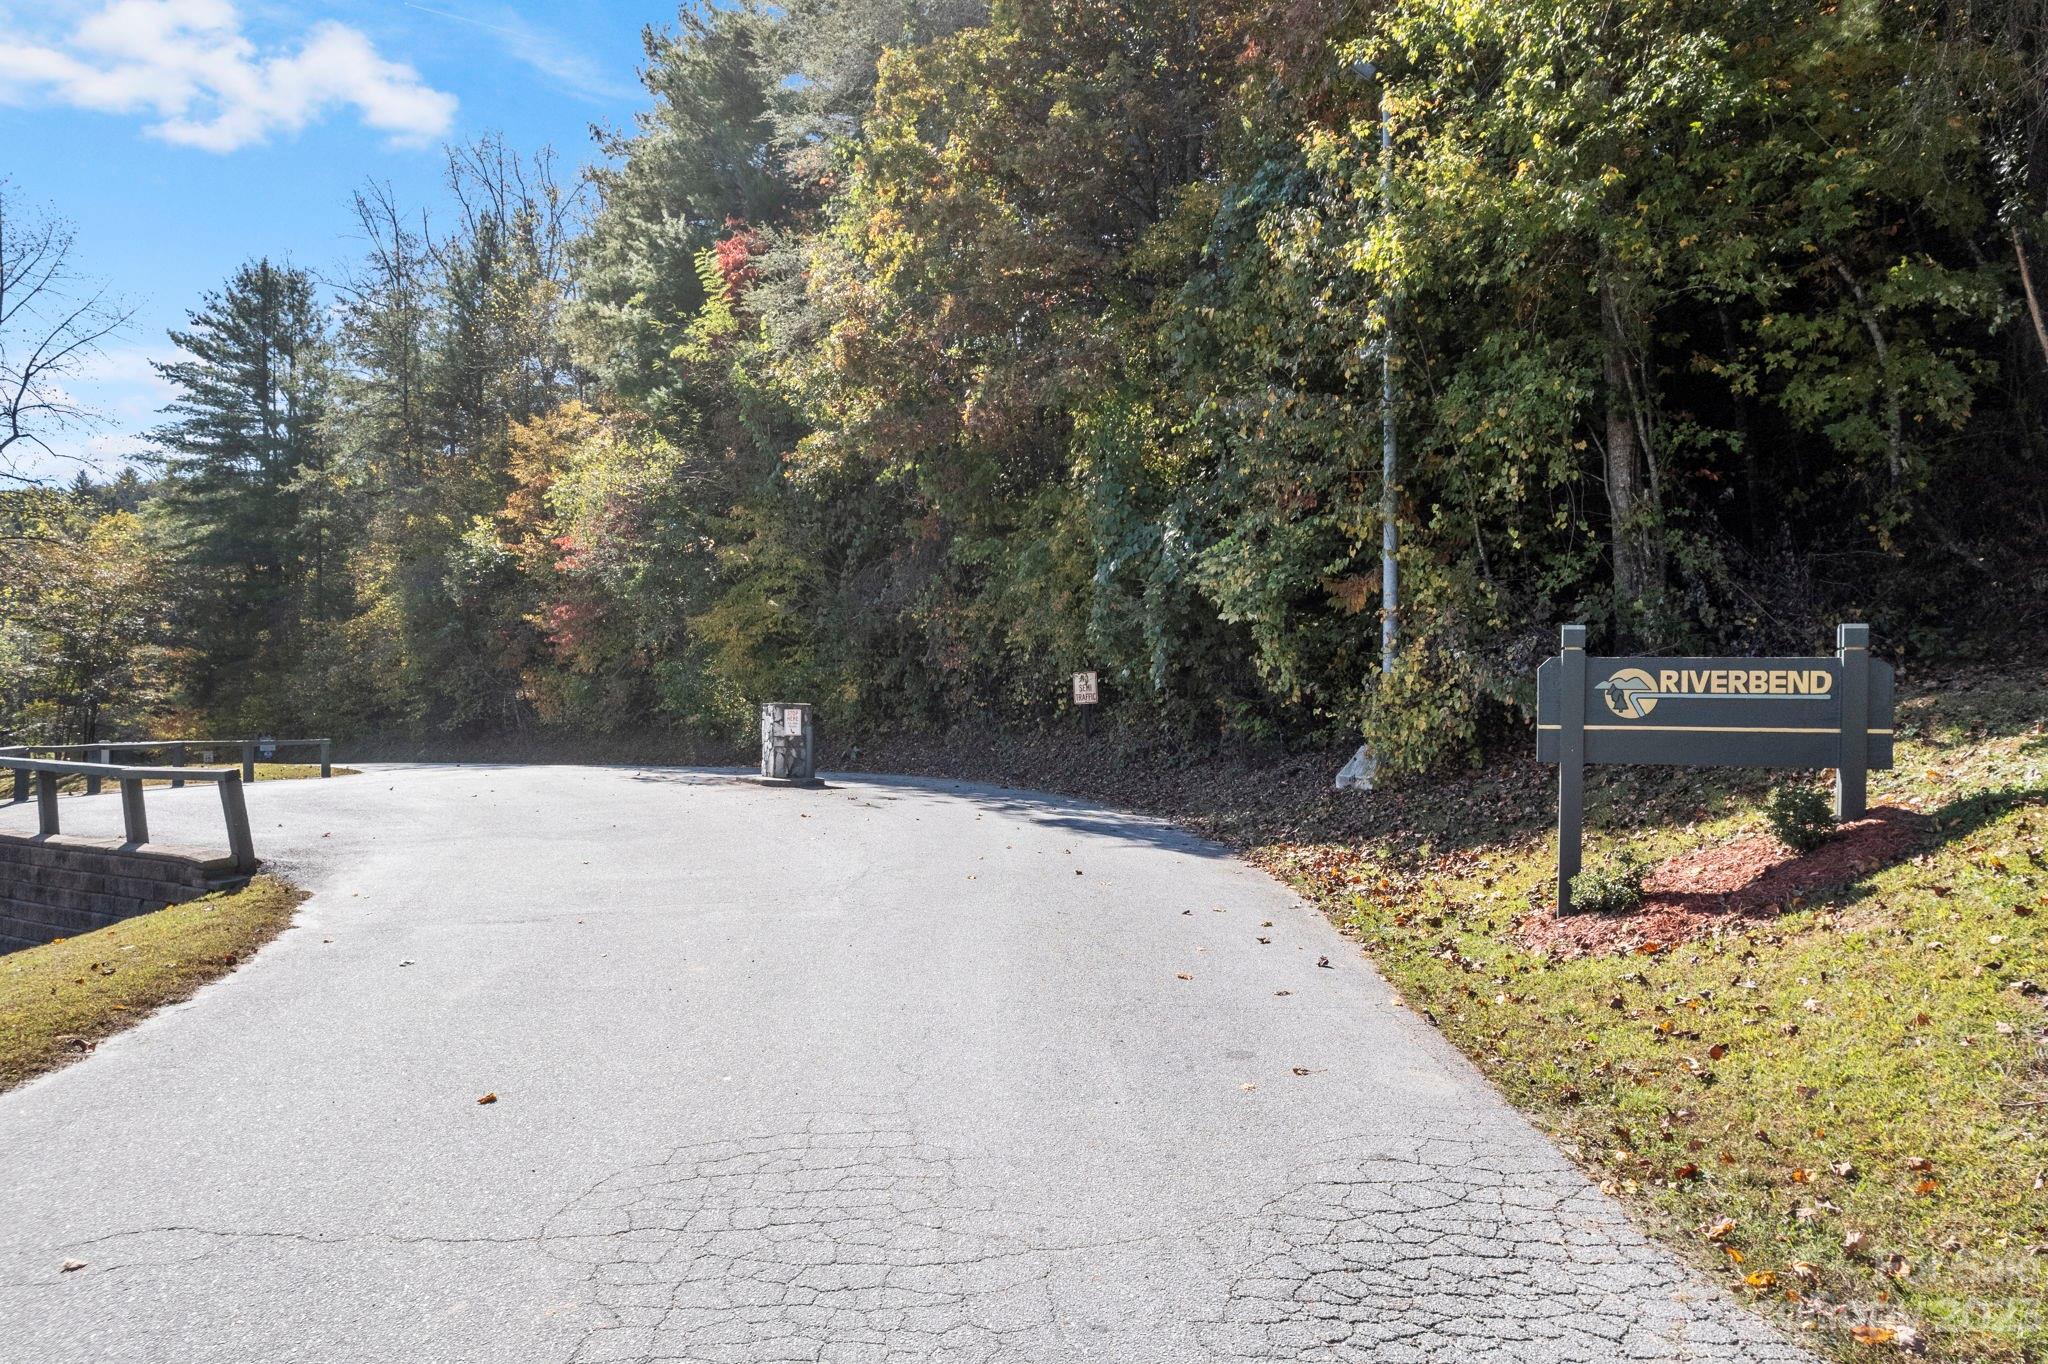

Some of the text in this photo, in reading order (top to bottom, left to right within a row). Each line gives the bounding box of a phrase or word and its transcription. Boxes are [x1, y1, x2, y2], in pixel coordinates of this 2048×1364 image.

[1660, 669, 1833, 694] RIVERBEND
[1079, 684, 1092, 692] SEMI
[1075, 693, 1096, 701] TRAFFIC
